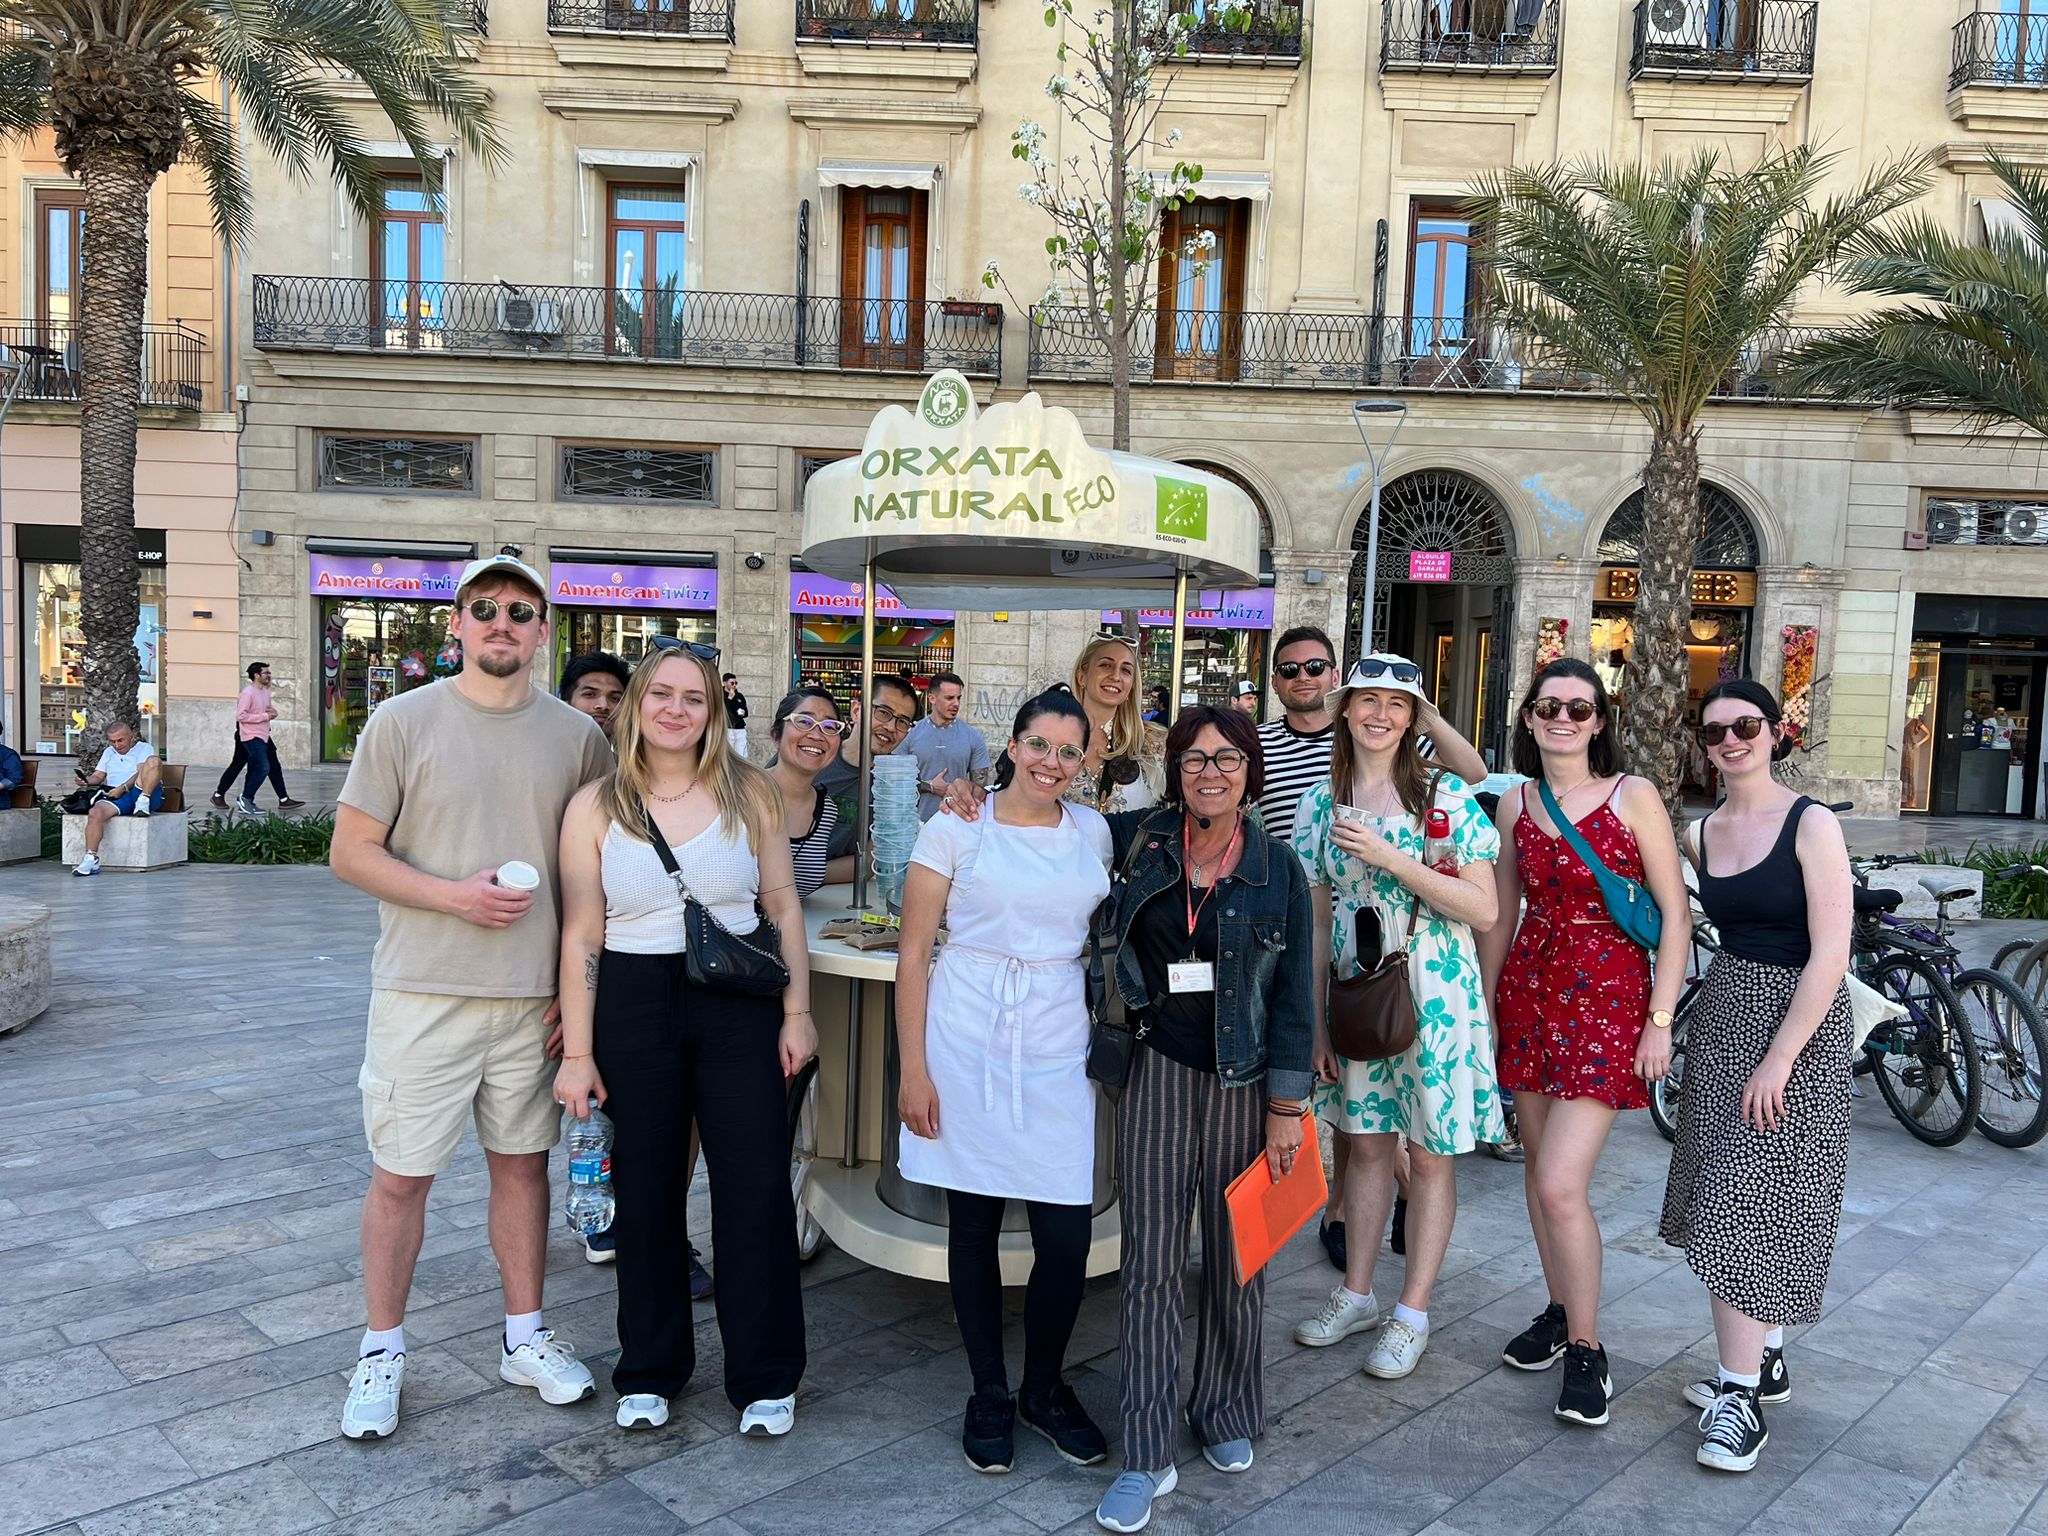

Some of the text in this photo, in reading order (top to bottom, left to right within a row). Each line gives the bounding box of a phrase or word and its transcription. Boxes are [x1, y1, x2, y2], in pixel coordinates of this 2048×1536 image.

[925, 407, 965, 425] ORXATA
[862, 446, 1064, 480] ORXATA
[853, 474, 1115, 524] NATURAL ECO
[317, 570, 421, 591] American
[556, 579, 660, 601] American
